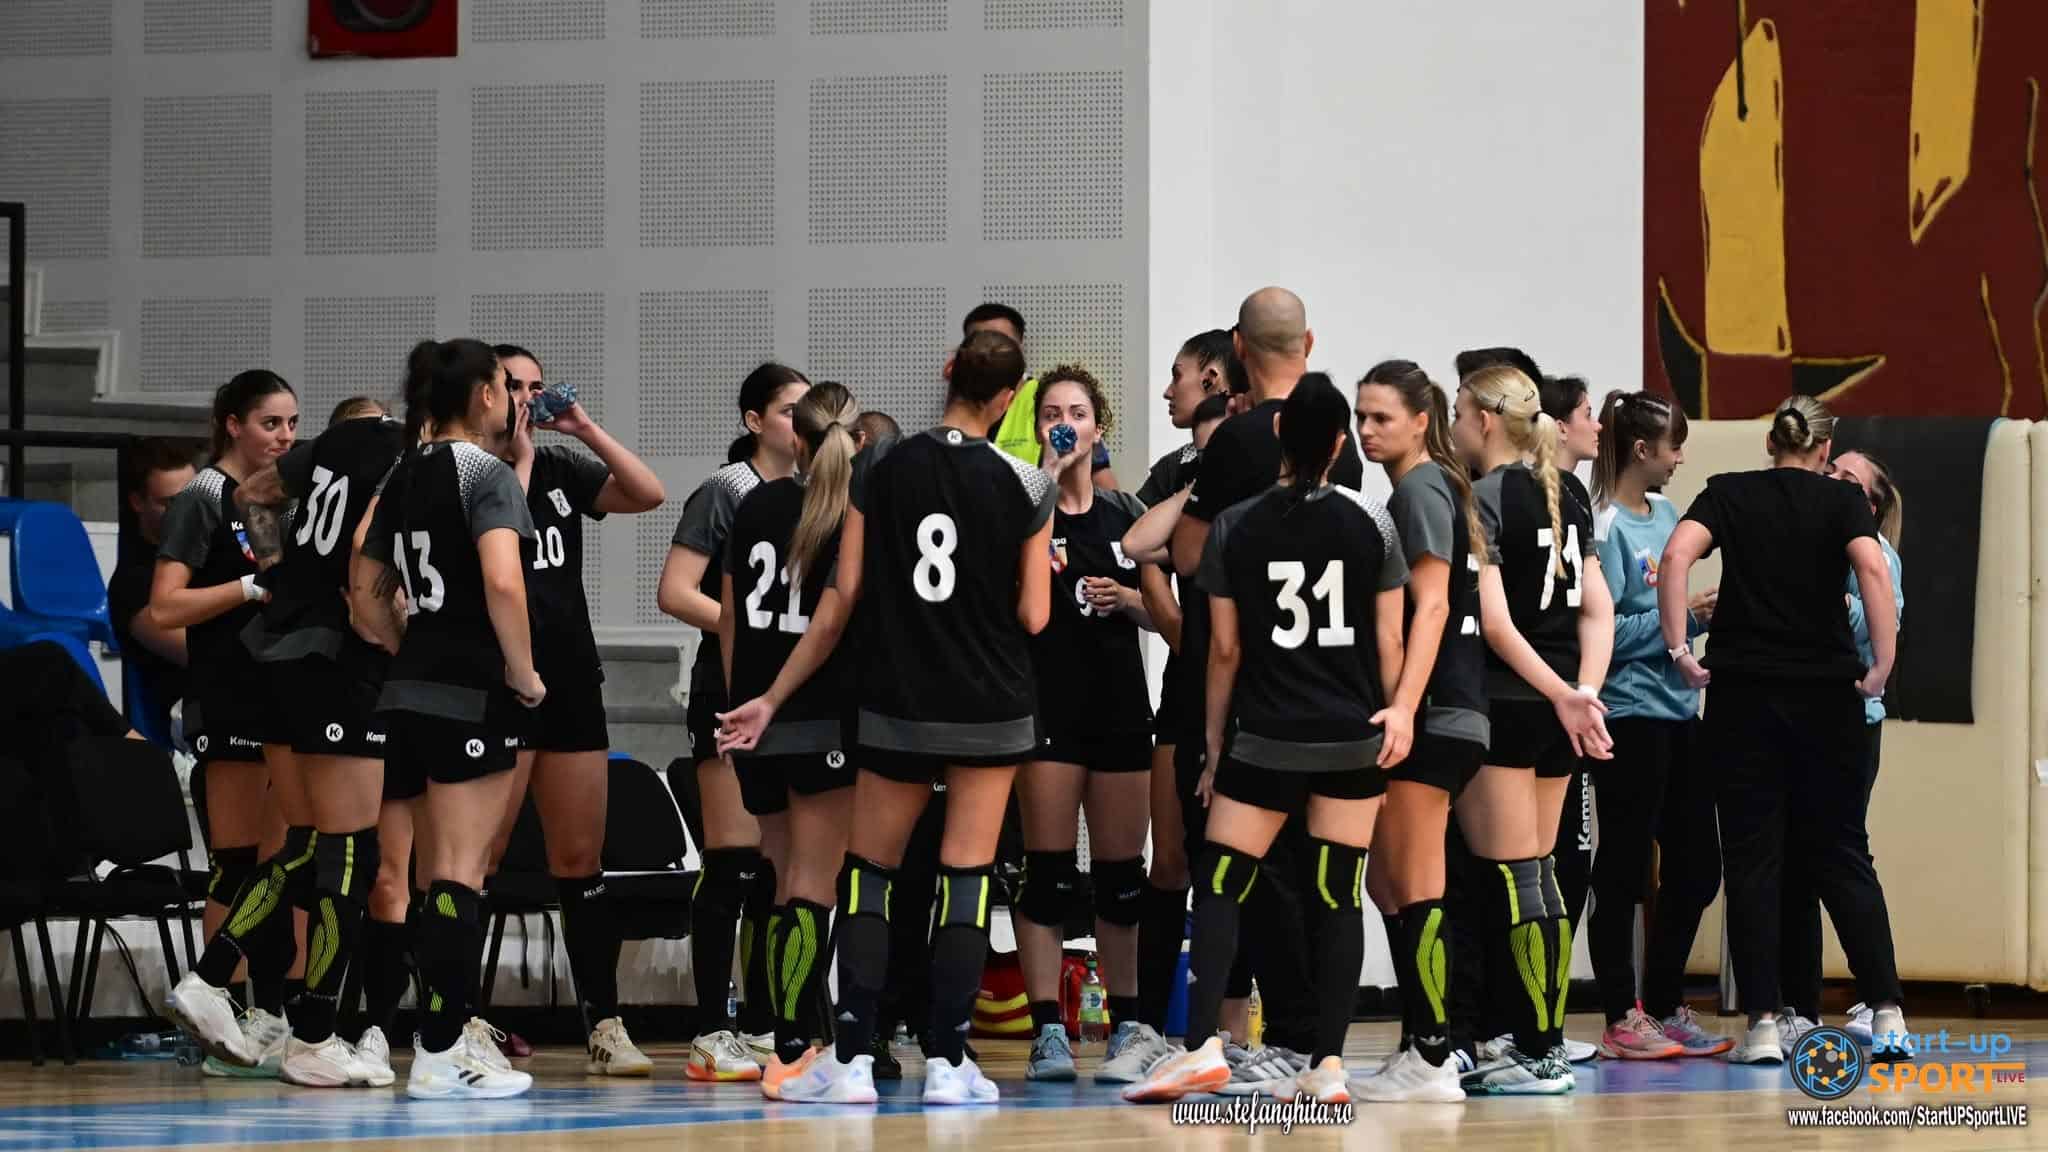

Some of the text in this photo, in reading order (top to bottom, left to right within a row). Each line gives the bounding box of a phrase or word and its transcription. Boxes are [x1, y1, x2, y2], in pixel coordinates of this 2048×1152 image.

[296, 465, 349, 556] 30
[533, 526, 565, 570] 10
[393, 530, 445, 615] 13
[746, 541, 810, 633] 21
[913, 512, 958, 602] 8
[1537, 524, 1583, 611] 71
[1268, 560, 1355, 649] 31
[1577, 772, 1592, 851] Kempa
